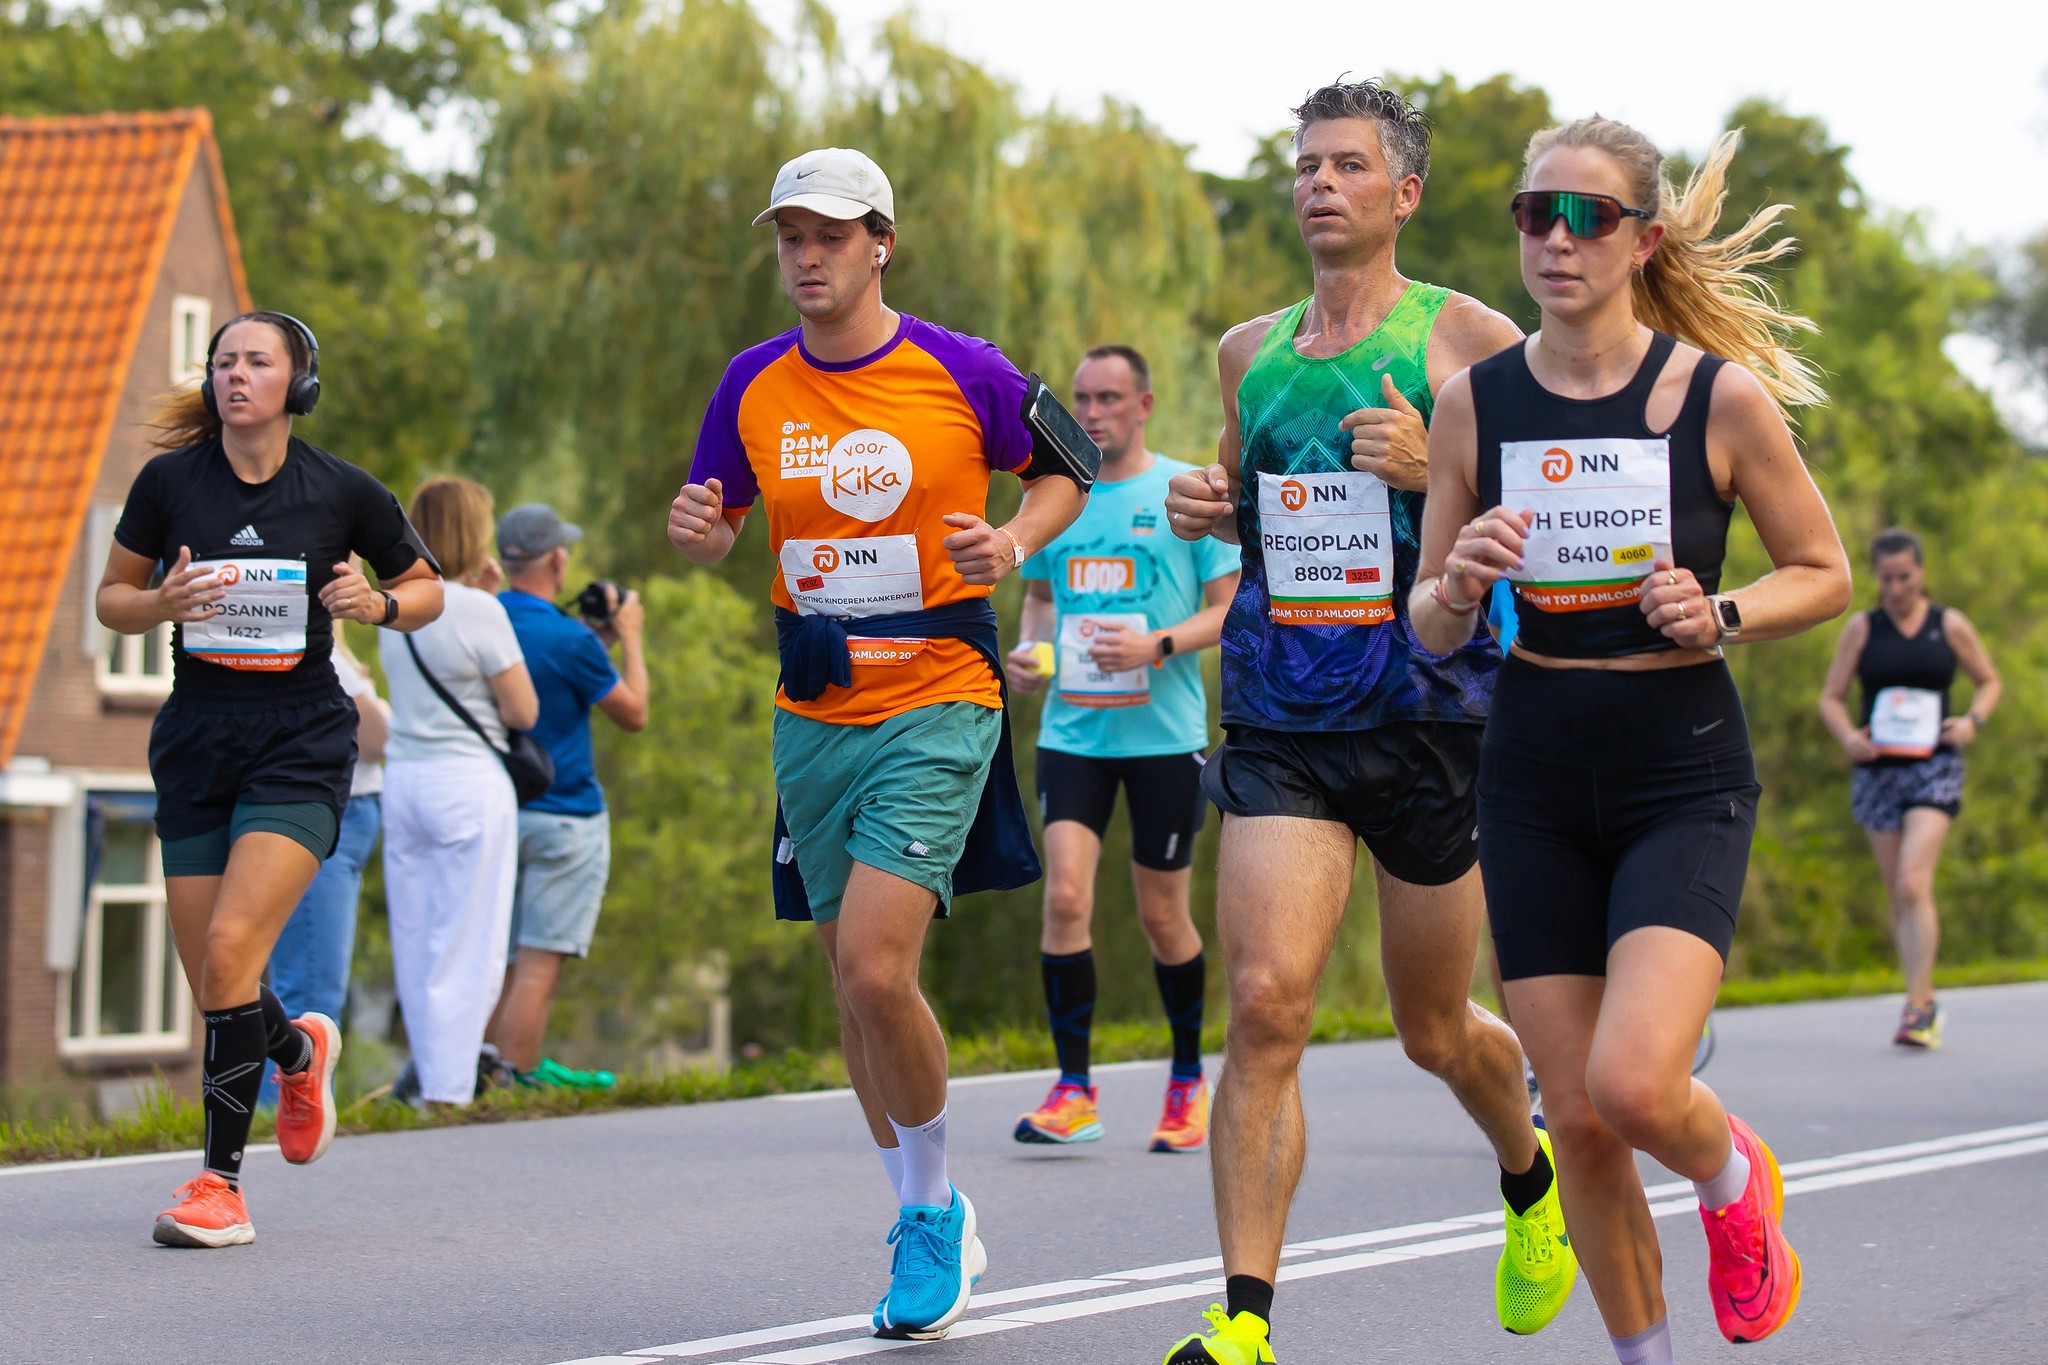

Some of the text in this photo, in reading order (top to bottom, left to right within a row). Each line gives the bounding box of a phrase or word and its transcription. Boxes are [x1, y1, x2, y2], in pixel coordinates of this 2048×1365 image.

[795, 422, 811, 431] NN
[781, 435, 829, 453] DAM
[843, 442, 888, 457] voor
[780, 450, 828, 468] DAM
[1581, 454, 1618, 472] NN
[1313, 485, 1347, 502] NN
[1532, 508, 1662, 530] H EUROPE
[230, 538, 264, 546] adidas
[1264, 533, 1378, 551] REGIOPLAN
[844, 548, 878, 566] NN
[1557, 546, 1608, 563] 8410
[245, 568, 273, 582] NN
[1074, 561, 1128, 594] LOOP
[1295, 566, 1344, 582] 8802
[1352, 571, 1374, 581] 3252
[825, 597, 865, 605] KINDEREN
[867, 592, 919, 603] KANKERVRIJ
[1553, 593, 1577, 606] TOT
[1294, 609, 1314, 618] TOT
[1316, 608, 1366, 618] DAMLOOP
[227, 626, 262, 638] 1422
[221, 657, 239, 666] TOT
[240, 658, 282, 666] DAMLOOP
[909, 840, 930, 857] NIKE
